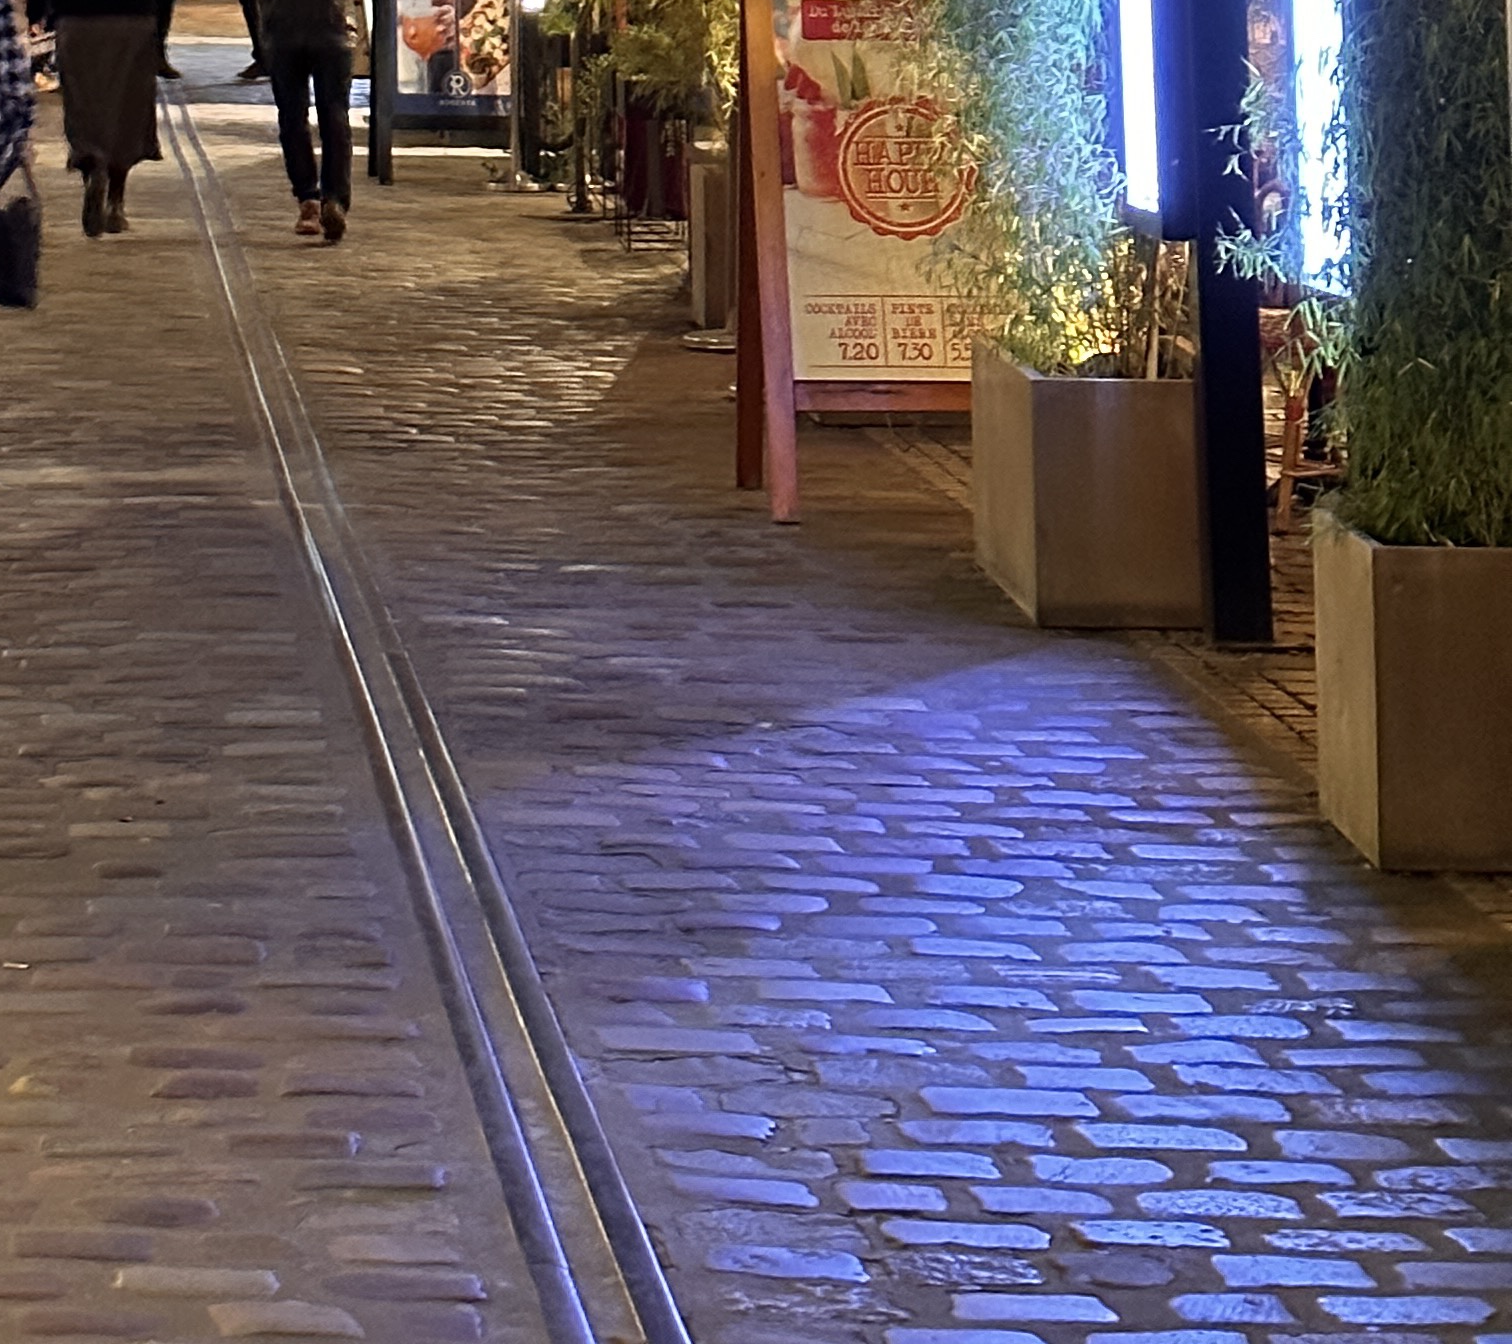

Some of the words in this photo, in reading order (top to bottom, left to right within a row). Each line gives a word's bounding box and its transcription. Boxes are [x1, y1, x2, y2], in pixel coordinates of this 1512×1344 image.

[805, 303, 876, 314] COCKTAILS
[891, 303, 934, 314] PINTE
[844, 316, 877, 327] AVEC
[829, 328, 877, 339] ALCOOL
